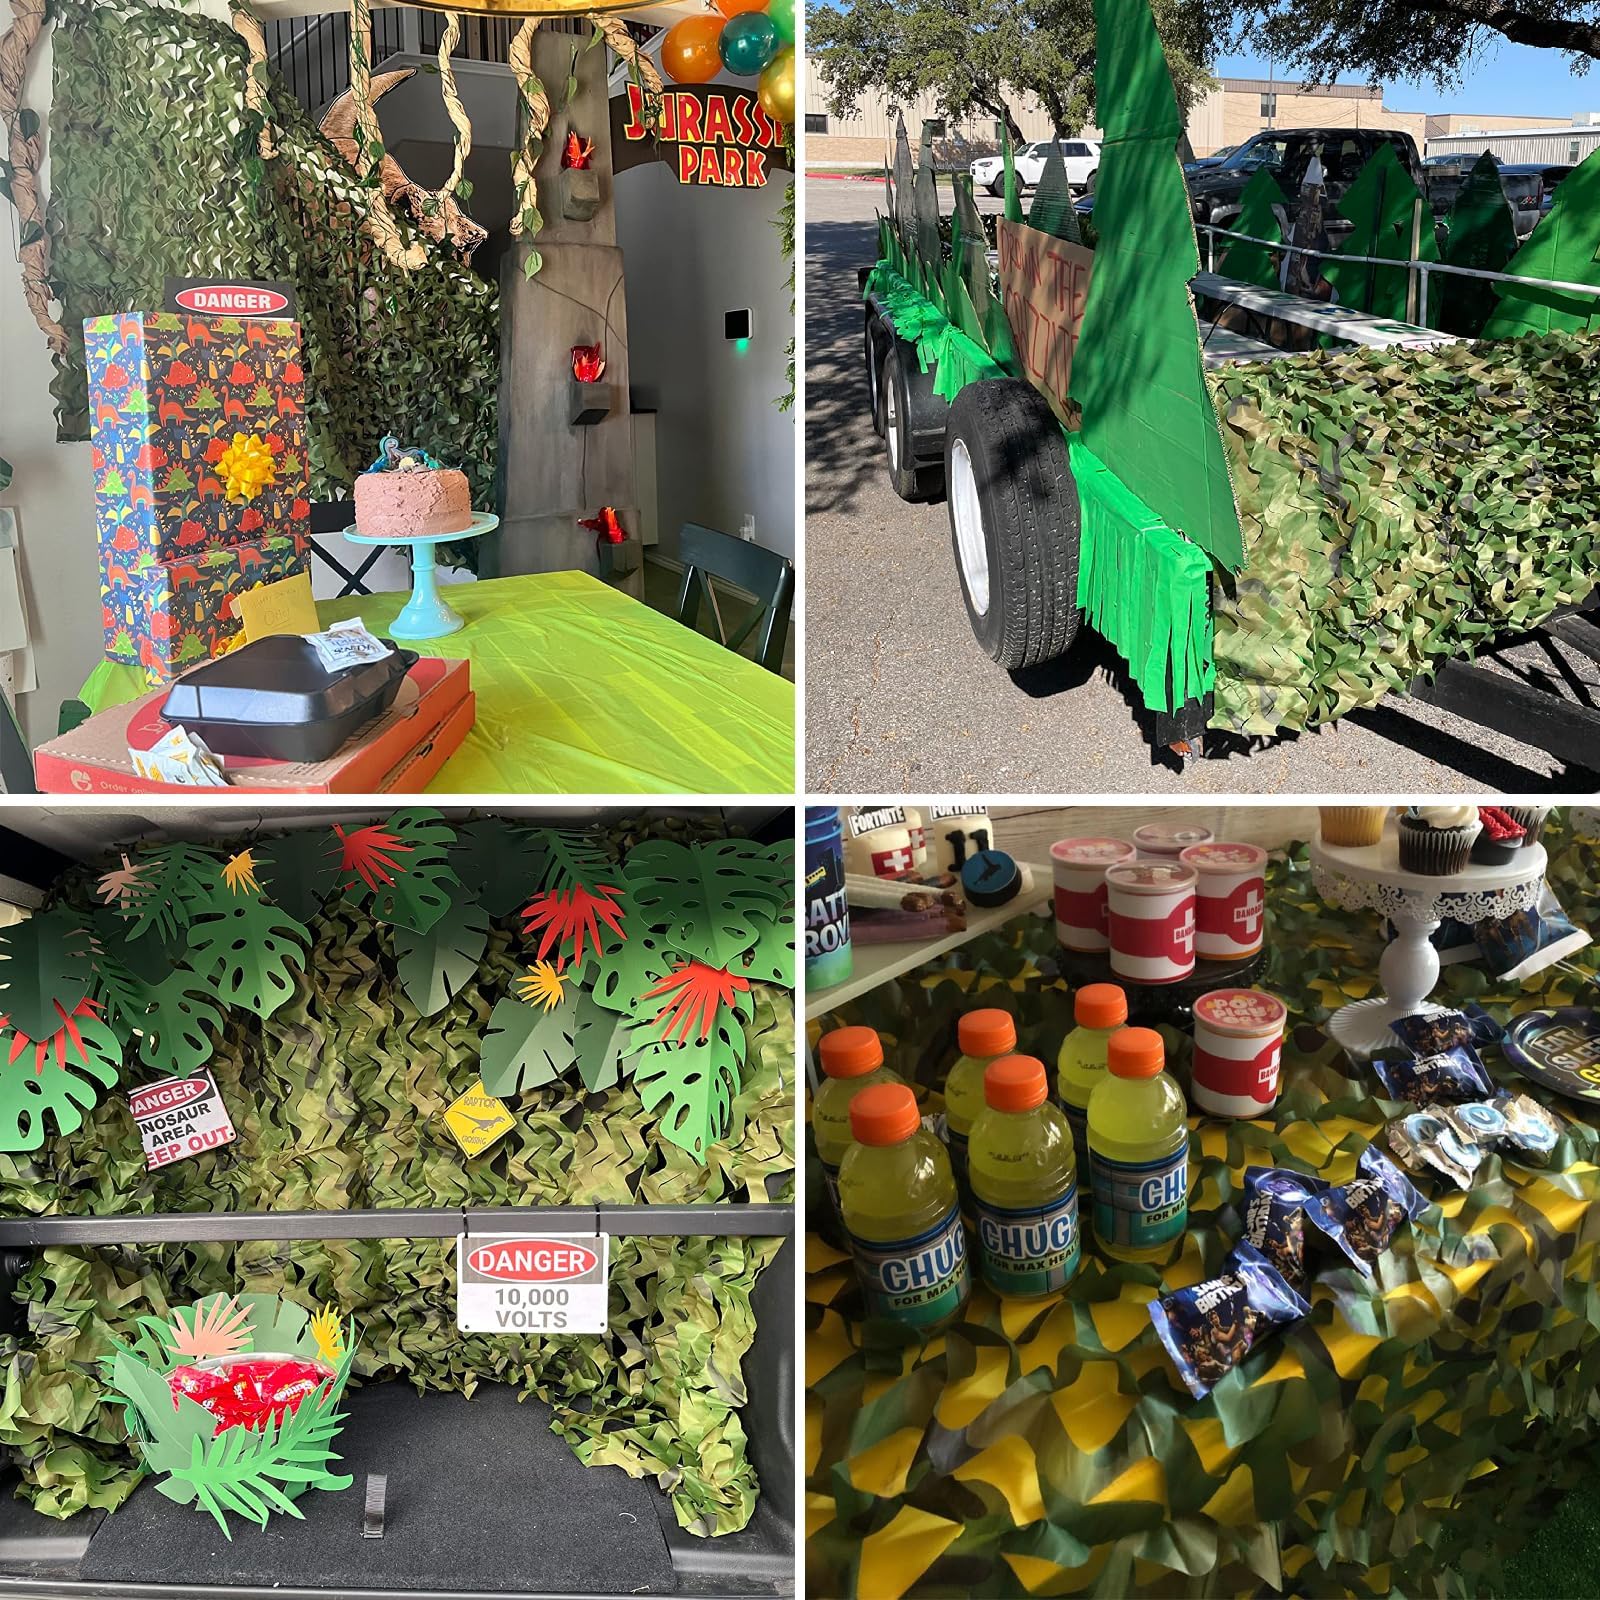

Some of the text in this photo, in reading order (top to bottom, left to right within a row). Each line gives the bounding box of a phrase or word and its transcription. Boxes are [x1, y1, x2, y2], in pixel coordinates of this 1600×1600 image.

[679, 145, 768, 187] PARK
[1047, 251, 1085, 322] THE
[194, 293, 271, 309] DANGER
[100, 781, 128, 793] Order
[851, 807, 906, 835] FORTNITE
[1534, 1030, 1580, 1054] EAT
[464, 1096, 496, 1109] RAPTOR
[152, 1124, 197, 1147] AREA
[188, 1126, 228, 1151] OUT
[1146, 1211, 1168, 1223] FOR
[980, 1213, 1071, 1259] CHUG
[478, 1250, 586, 1272] DANGER
[988, 1256, 1011, 1271] FOR
[1014, 1256, 1046, 1272] MAX
[495, 1288, 569, 1309] 10,000
[894, 1277, 954, 1306] FOR MAX
[495, 1310, 568, 1328] VOLTS
